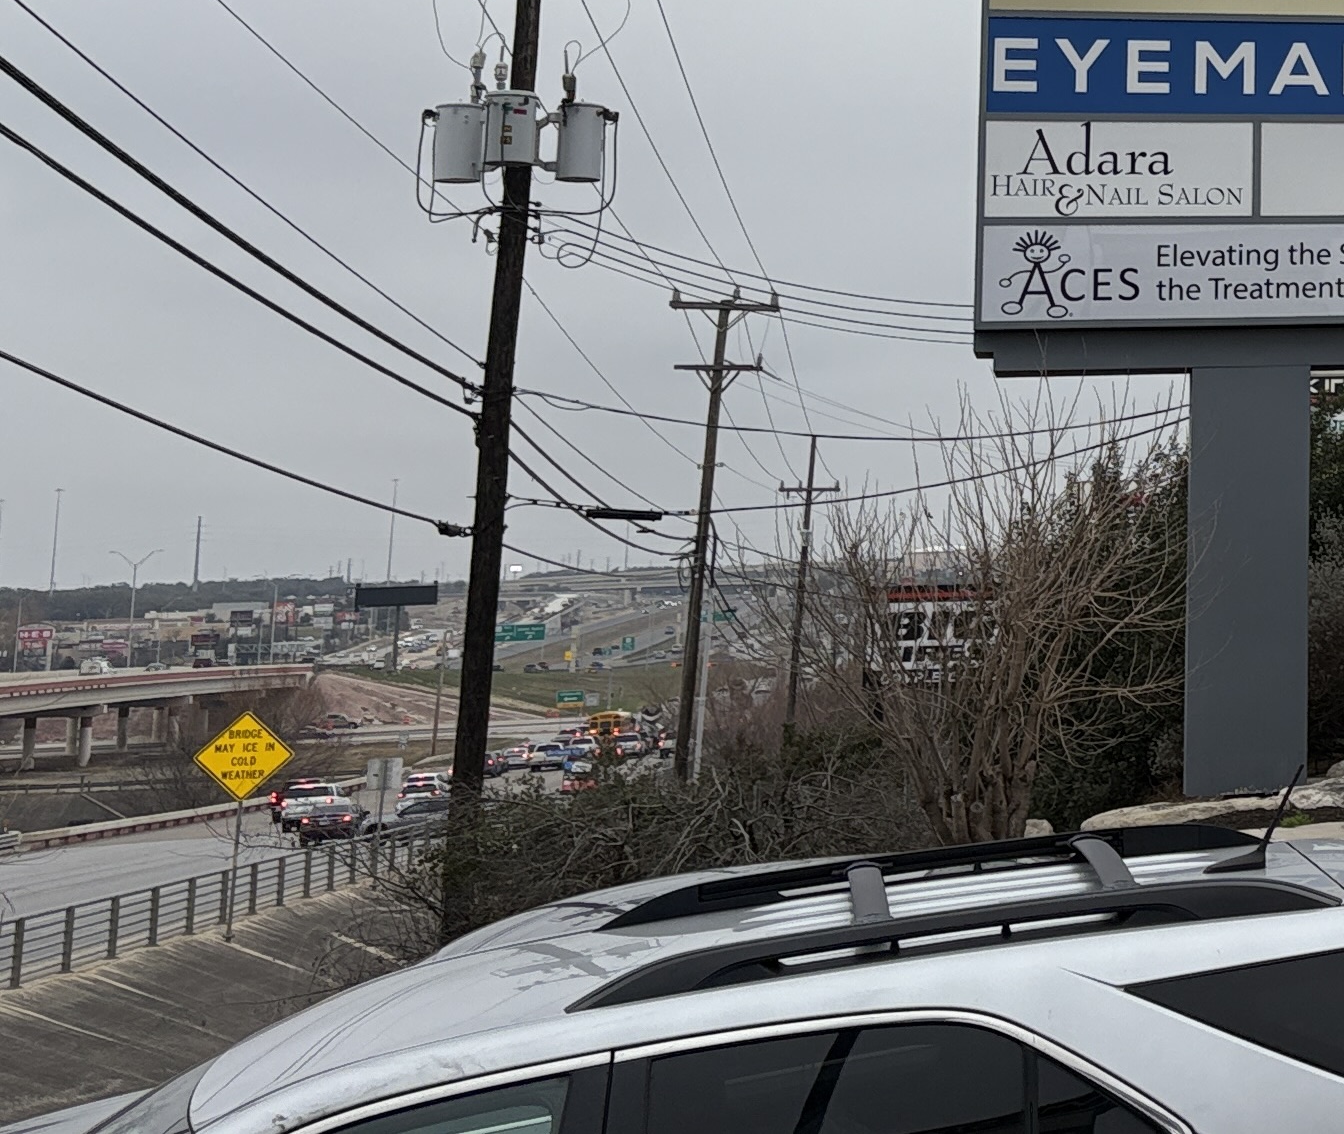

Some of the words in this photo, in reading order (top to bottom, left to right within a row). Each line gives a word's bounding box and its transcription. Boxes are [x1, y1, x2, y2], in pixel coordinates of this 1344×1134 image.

[1016, 122, 1174, 176] Adara
[1054, 184, 1085, 216] &
[1156, 243, 1279, 270] Elevating
[1288, 243, 1332, 266] the
[1013, 260, 1141, 303] ACES
[1156, 278, 1201, 301] the
[1208, 276, 1344, 301] Treatment
[228, 728, 263, 740] BRIDGE
[214, 744, 236, 754] MAY
[242, 743, 258, 753] ICE
[265, 741, 276, 752] IN
[231, 756, 257, 767] COLD
[221, 769, 265, 781] WEATHER
